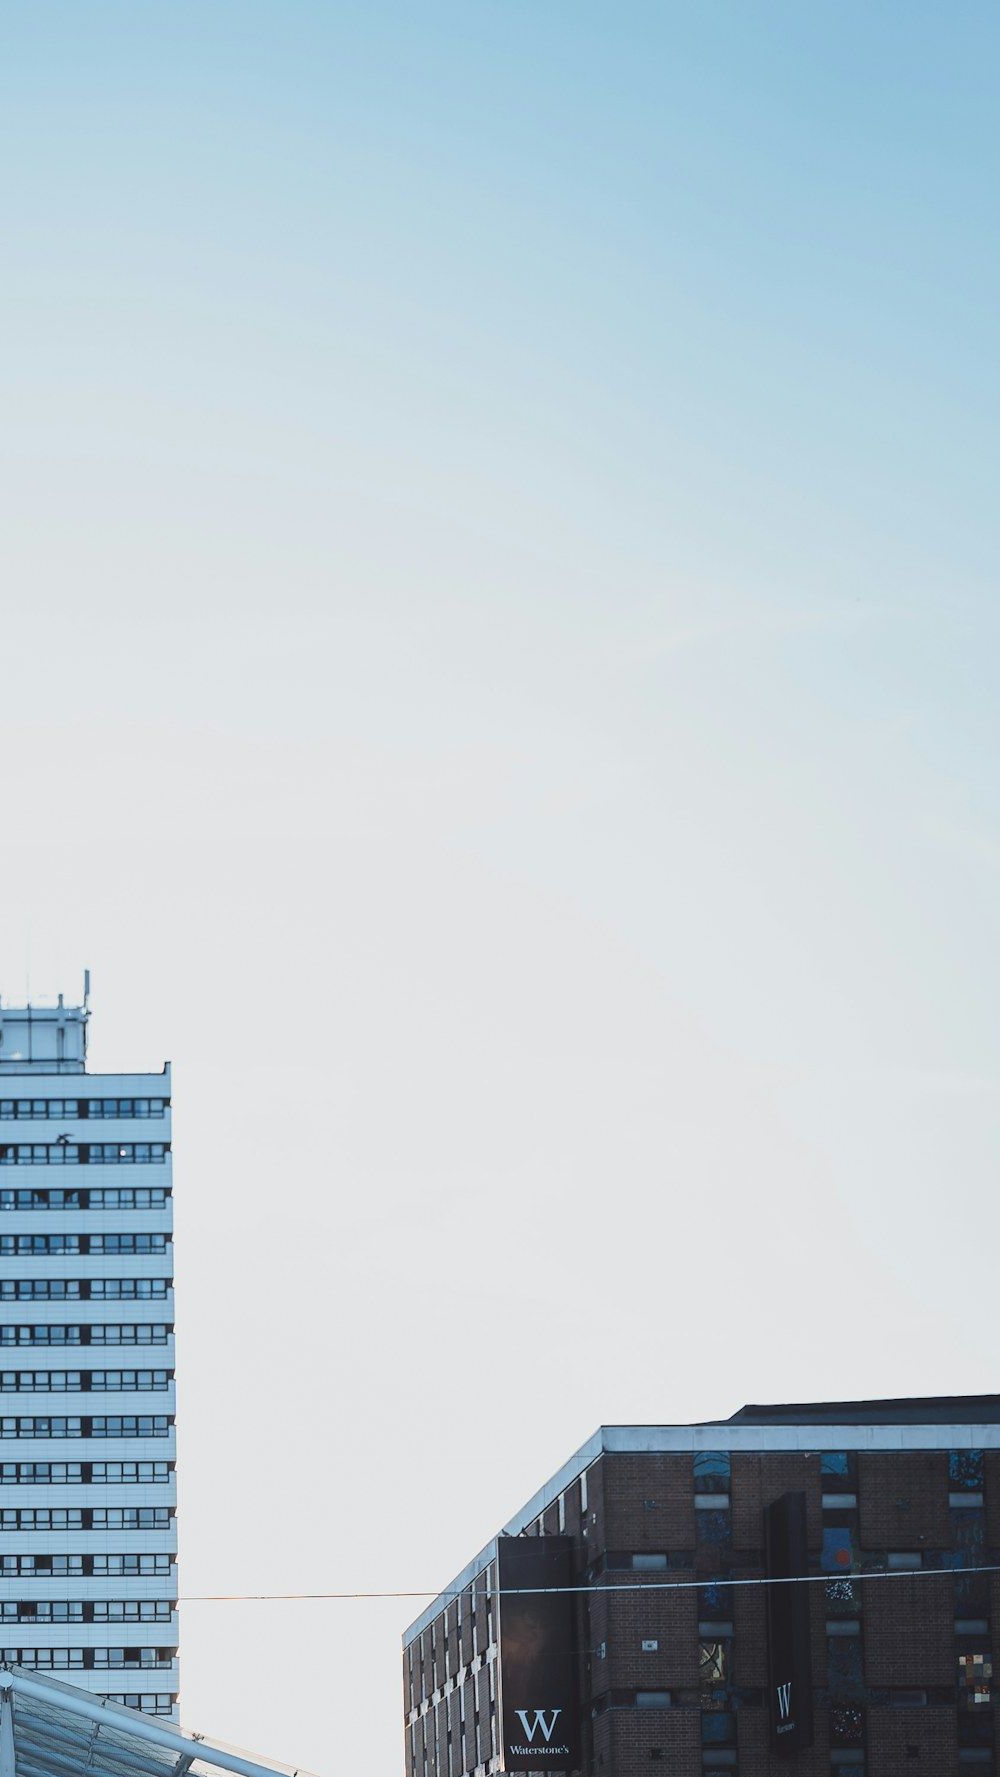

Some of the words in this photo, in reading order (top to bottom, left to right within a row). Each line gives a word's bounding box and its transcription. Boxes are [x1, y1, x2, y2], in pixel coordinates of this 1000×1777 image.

[776, 1682, 792, 1719] W
[514, 1709, 562, 1742] W
[510, 1745, 569, 1755] Waterstone's
